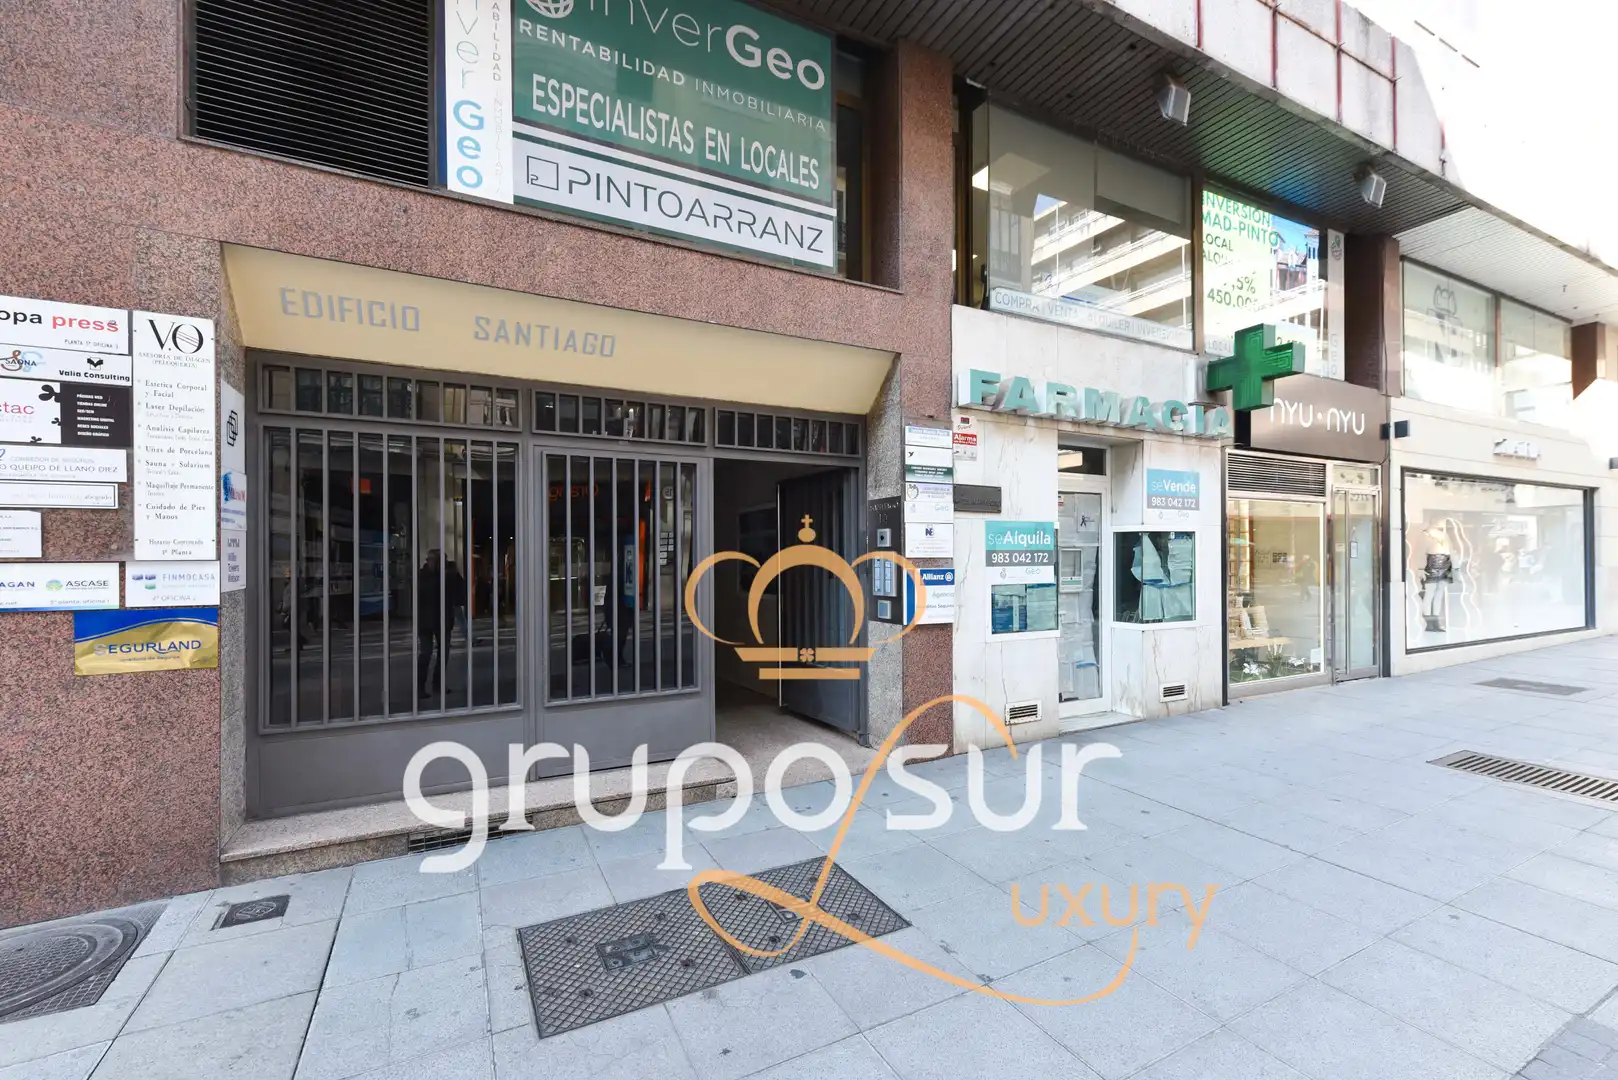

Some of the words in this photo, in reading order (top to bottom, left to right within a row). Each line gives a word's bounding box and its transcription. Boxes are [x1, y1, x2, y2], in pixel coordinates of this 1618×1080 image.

[519, 18, 686, 86] RENTABILIDAD
[695, 78, 827, 132] INMOBILIARIA
[532, 73, 695, 155] ESPECIALISTAS
[705, 127, 730, 165] EN
[741, 136, 820, 190] LOCALES
[568, 165, 824, 254] PINTOARRANZ
[1203, 233, 1234, 252] OCAL
[994, 291, 1040, 314] COMPRA
[52, 315, 119, 333] press
[279, 286, 421, 333] EDIFICIO
[473, 315, 617, 358] SANTIAGO
[59, 369, 82, 378] Valia
[84, 371, 131, 382] Consulting
[176, 382, 207, 392] Corporal
[153, 389, 174, 398] Facial
[967, 367, 1233, 437] FARMACIA
[167, 446, 176, 454] de
[179, 447, 213, 456] Porcelana
[10, 464, 46, 472] QUEIPO
[64, 465, 96, 473] LLANO
[145, 459, 167, 468] Sauna
[178, 460, 211, 470] Solarium
[180, 482, 215, 491] Permanente
[145, 503, 176, 511] Cuidado
[179, 503, 188, 511] de
[1151, 496, 1166, 507] 983
[1167, 497, 1183, 508] 042
[1184, 498, 1197, 509] 172
[155, 512, 179, 520] Manos
[171, 548, 192, 556] Planta
[991, 552, 1010, 563] 983
[1012, 552, 1032, 564] 042
[1033, 552, 1049, 563] 172
[922, 572, 945, 581] Allianz
[93, 640, 202, 657] SEGURLAND
